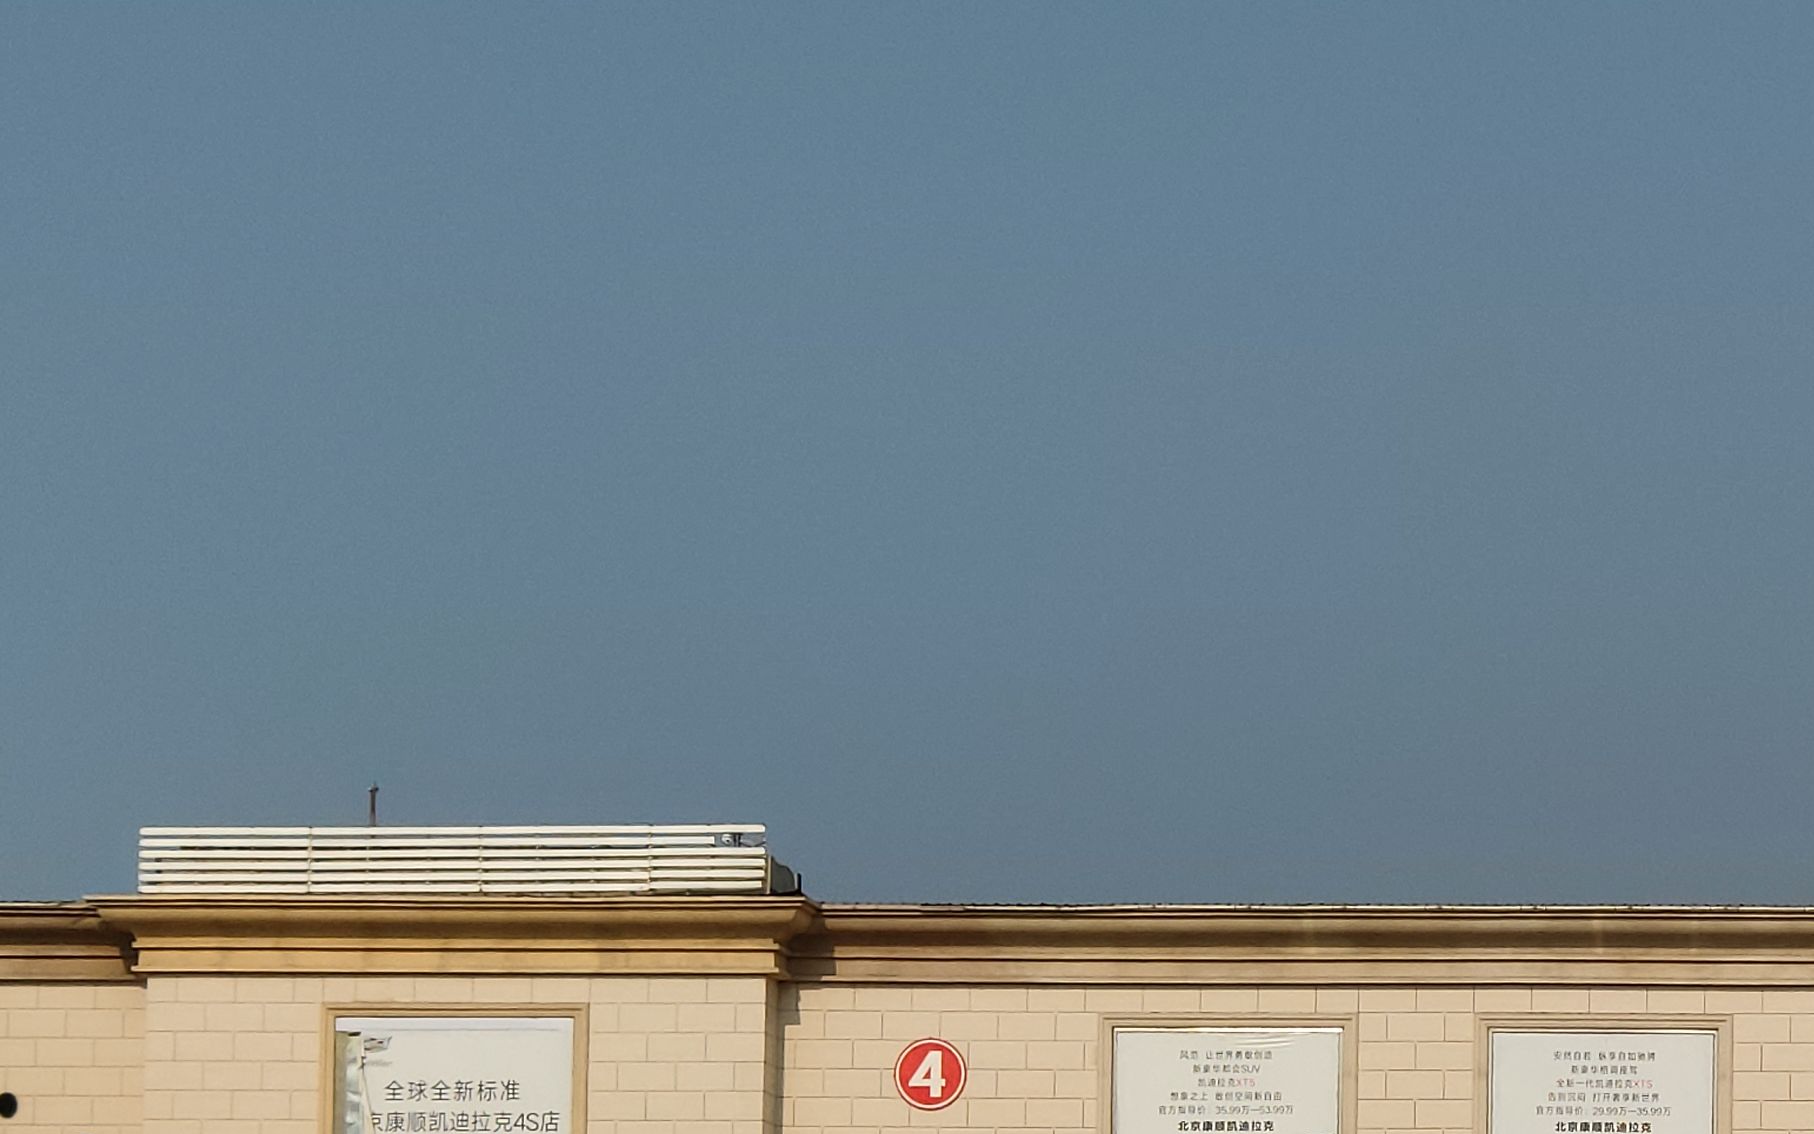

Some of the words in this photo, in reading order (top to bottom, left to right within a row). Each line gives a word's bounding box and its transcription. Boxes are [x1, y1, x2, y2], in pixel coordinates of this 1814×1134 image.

[908, 1050, 946, 1098] 4
[384, 1080, 521, 1101] 全球全新标准
[1178, 1120, 1274, 1132] 北京康顺凯迪拉克
[1555, 1121, 1652, 1133] 北京康顺凯迪拉克
